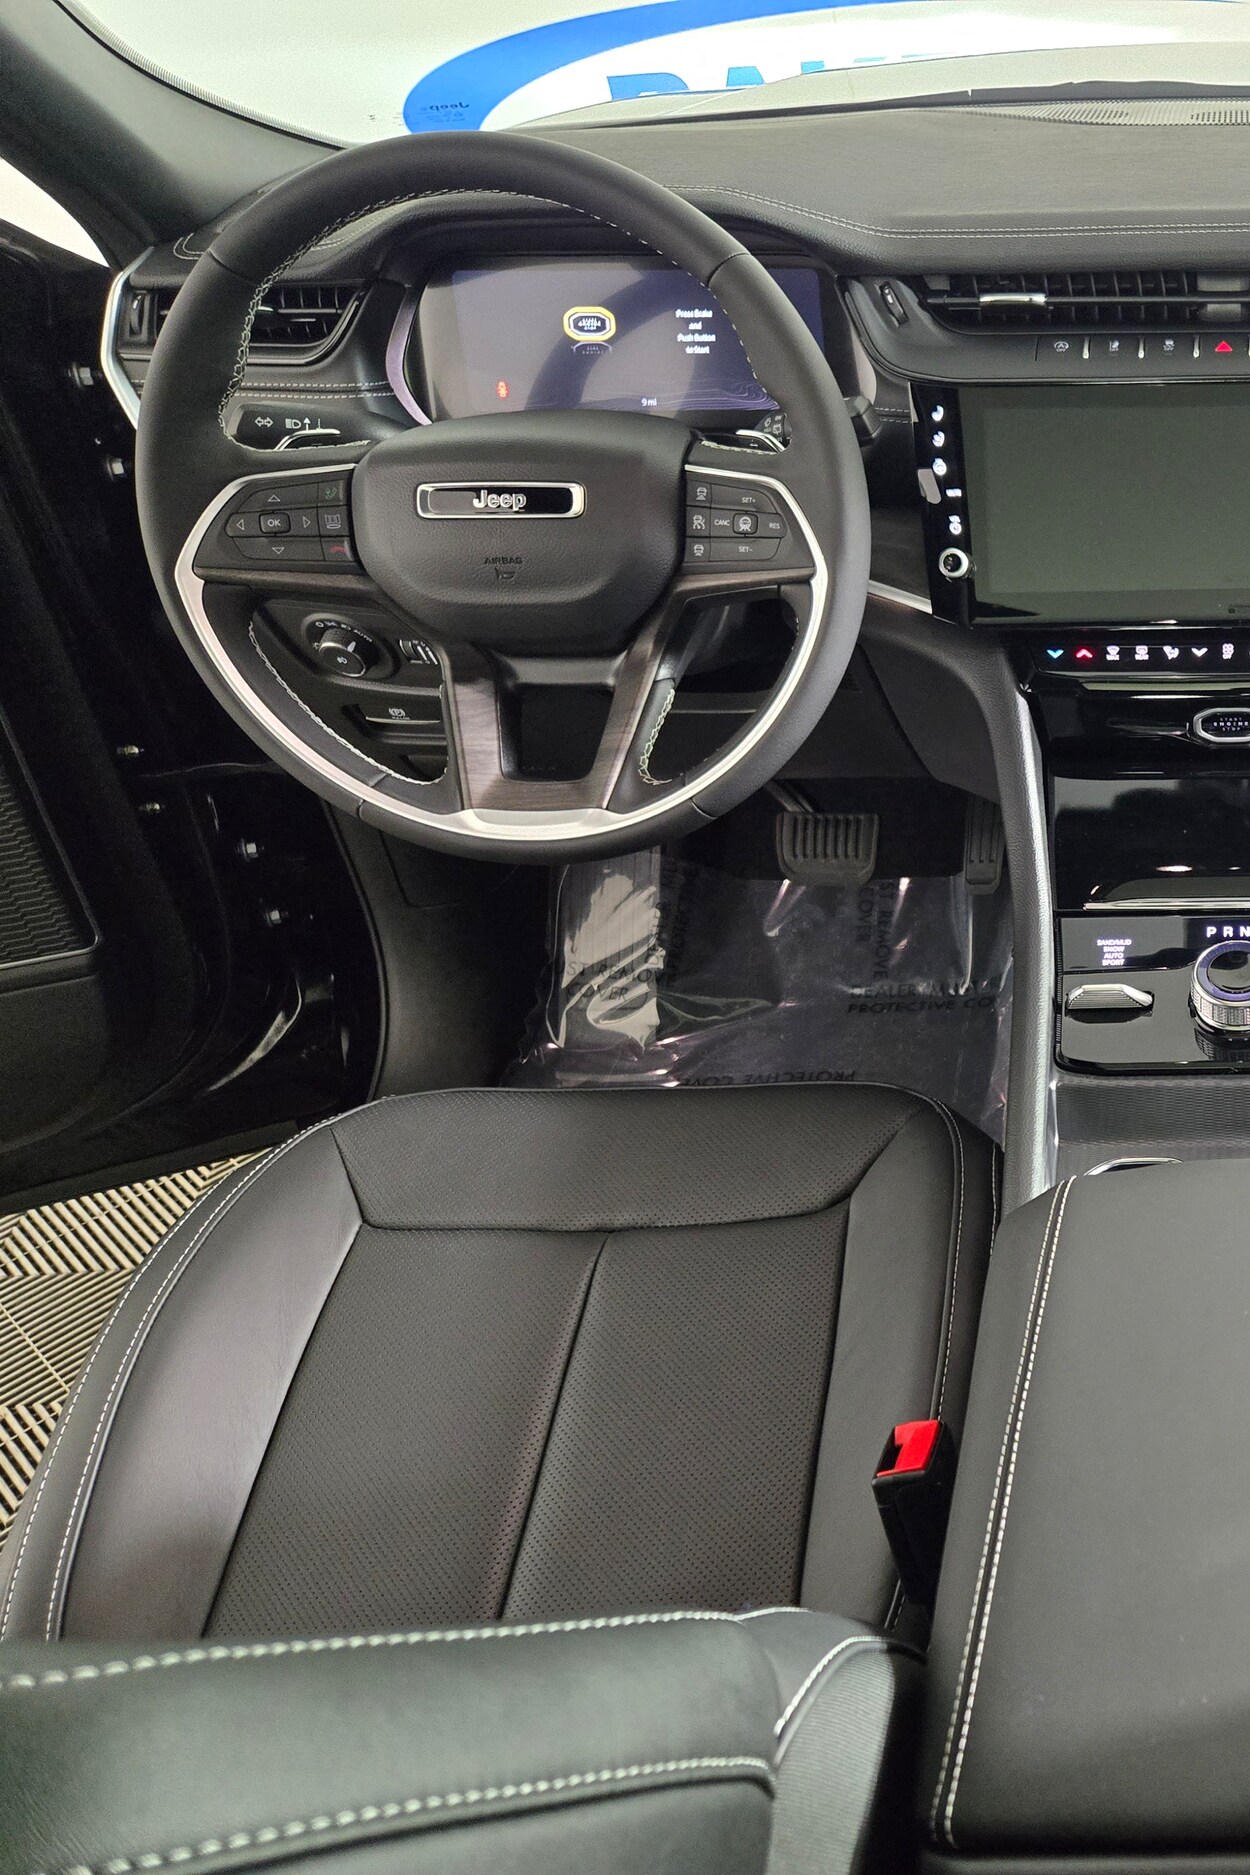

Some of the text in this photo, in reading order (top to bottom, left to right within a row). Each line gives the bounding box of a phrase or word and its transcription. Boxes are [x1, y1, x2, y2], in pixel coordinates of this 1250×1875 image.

[472, 489, 527, 512] Jeep
[267, 519, 281, 527] OK
[484, 557, 523, 565] AIRBAG
[848, 1001, 957, 1013] PROTECTIVE
